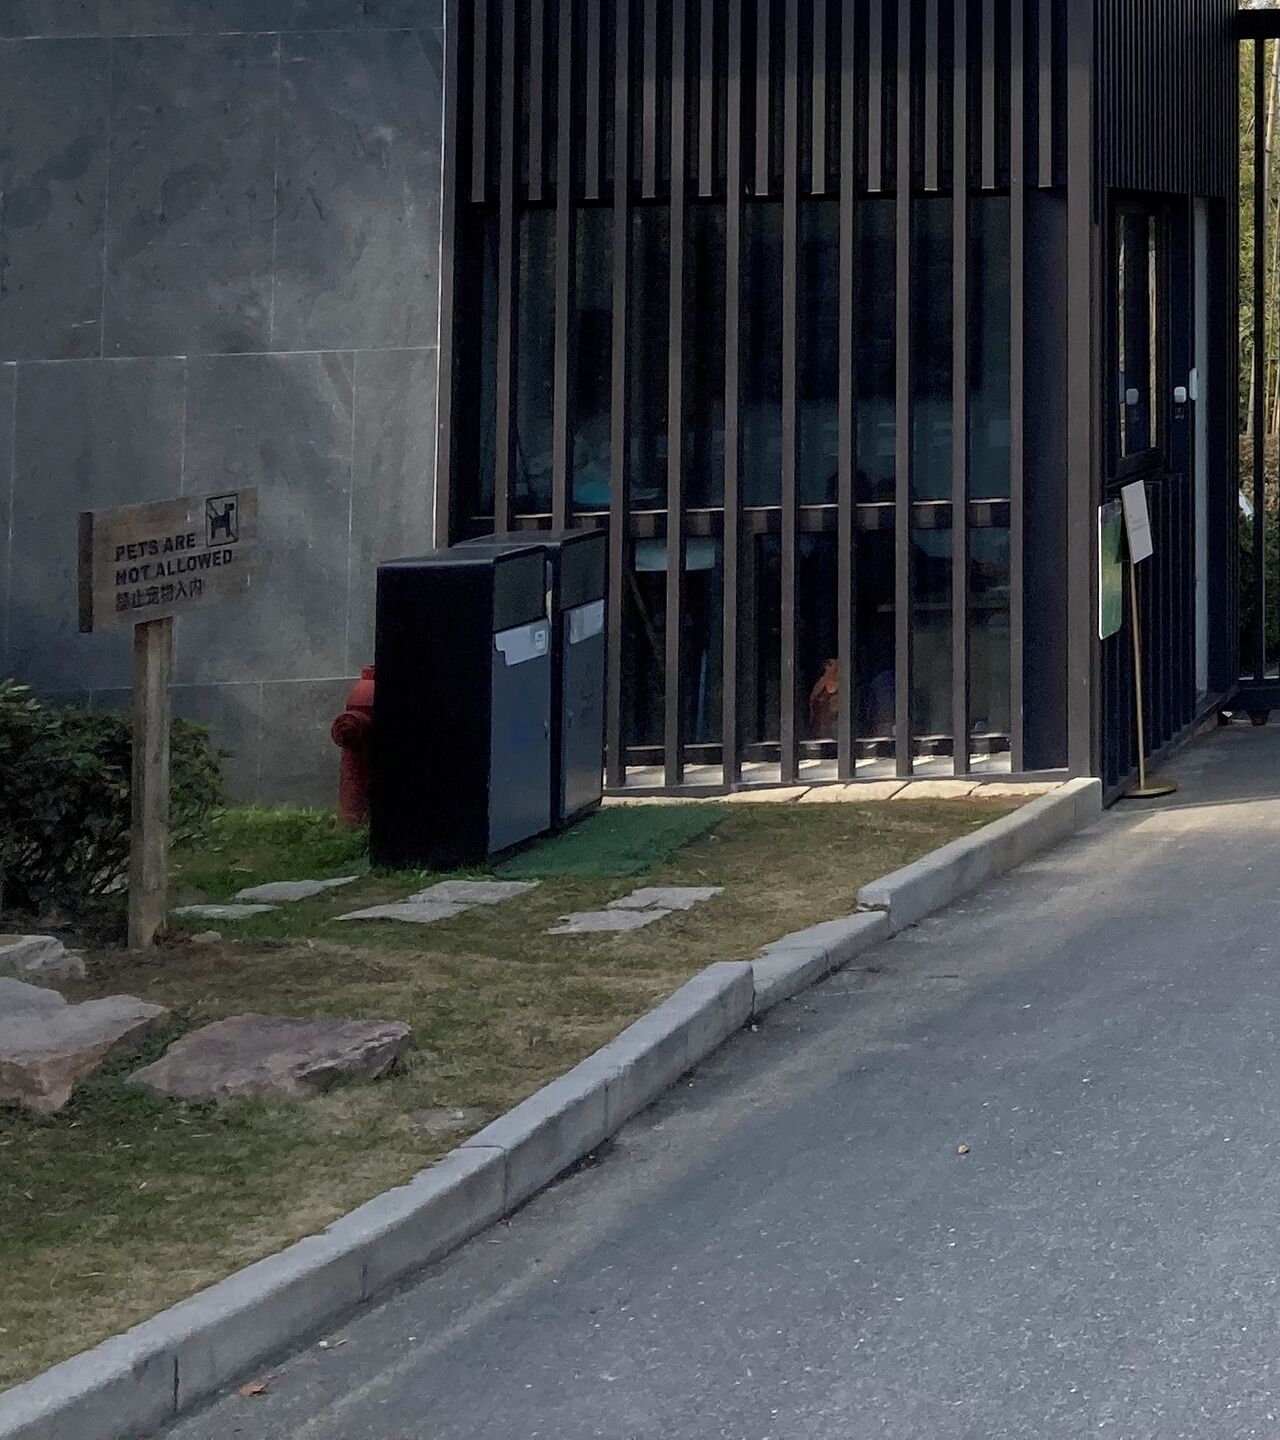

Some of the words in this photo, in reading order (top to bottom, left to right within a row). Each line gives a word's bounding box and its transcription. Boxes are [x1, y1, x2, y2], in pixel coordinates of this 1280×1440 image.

[115, 538, 159, 562] PETS
[163, 532, 197, 553] ARE
[115, 564, 152, 586] NOT
[156, 548, 233, 578] ALLOWED
[115, 577, 204, 612] 禁止宠物入内
